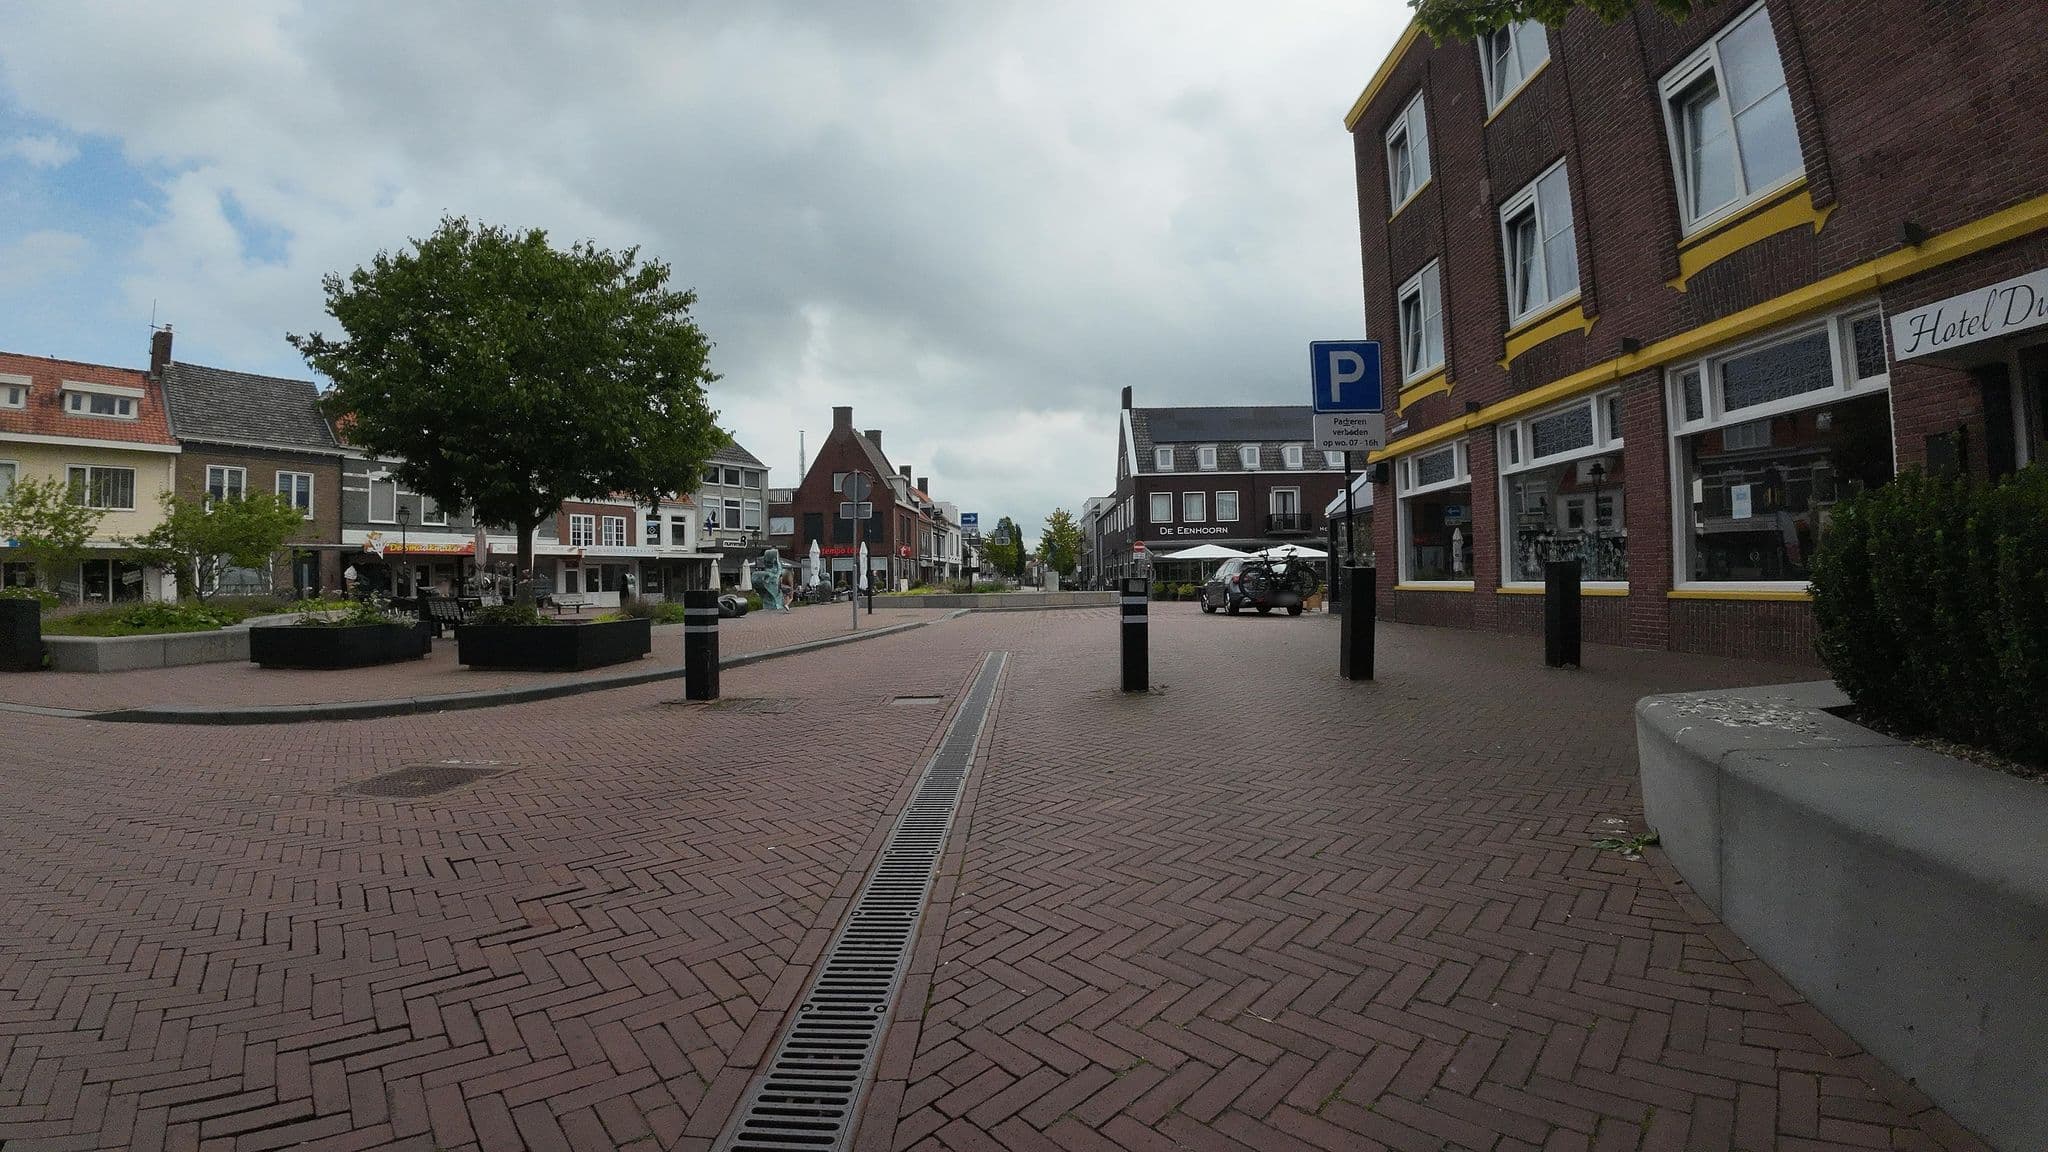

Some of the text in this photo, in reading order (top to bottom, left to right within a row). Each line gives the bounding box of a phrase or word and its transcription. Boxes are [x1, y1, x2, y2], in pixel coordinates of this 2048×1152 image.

[1904, 289, 1996, 353] Hotel
[1329, 350, 1365, 402] P
[1332, 428, 1368, 436] verboden
[1322, 440, 1333, 448] op
[1349, 439, 1358, 447] 07
[1365, 439, 1379, 447] 16h
[822, 546, 846, 555] tempo
